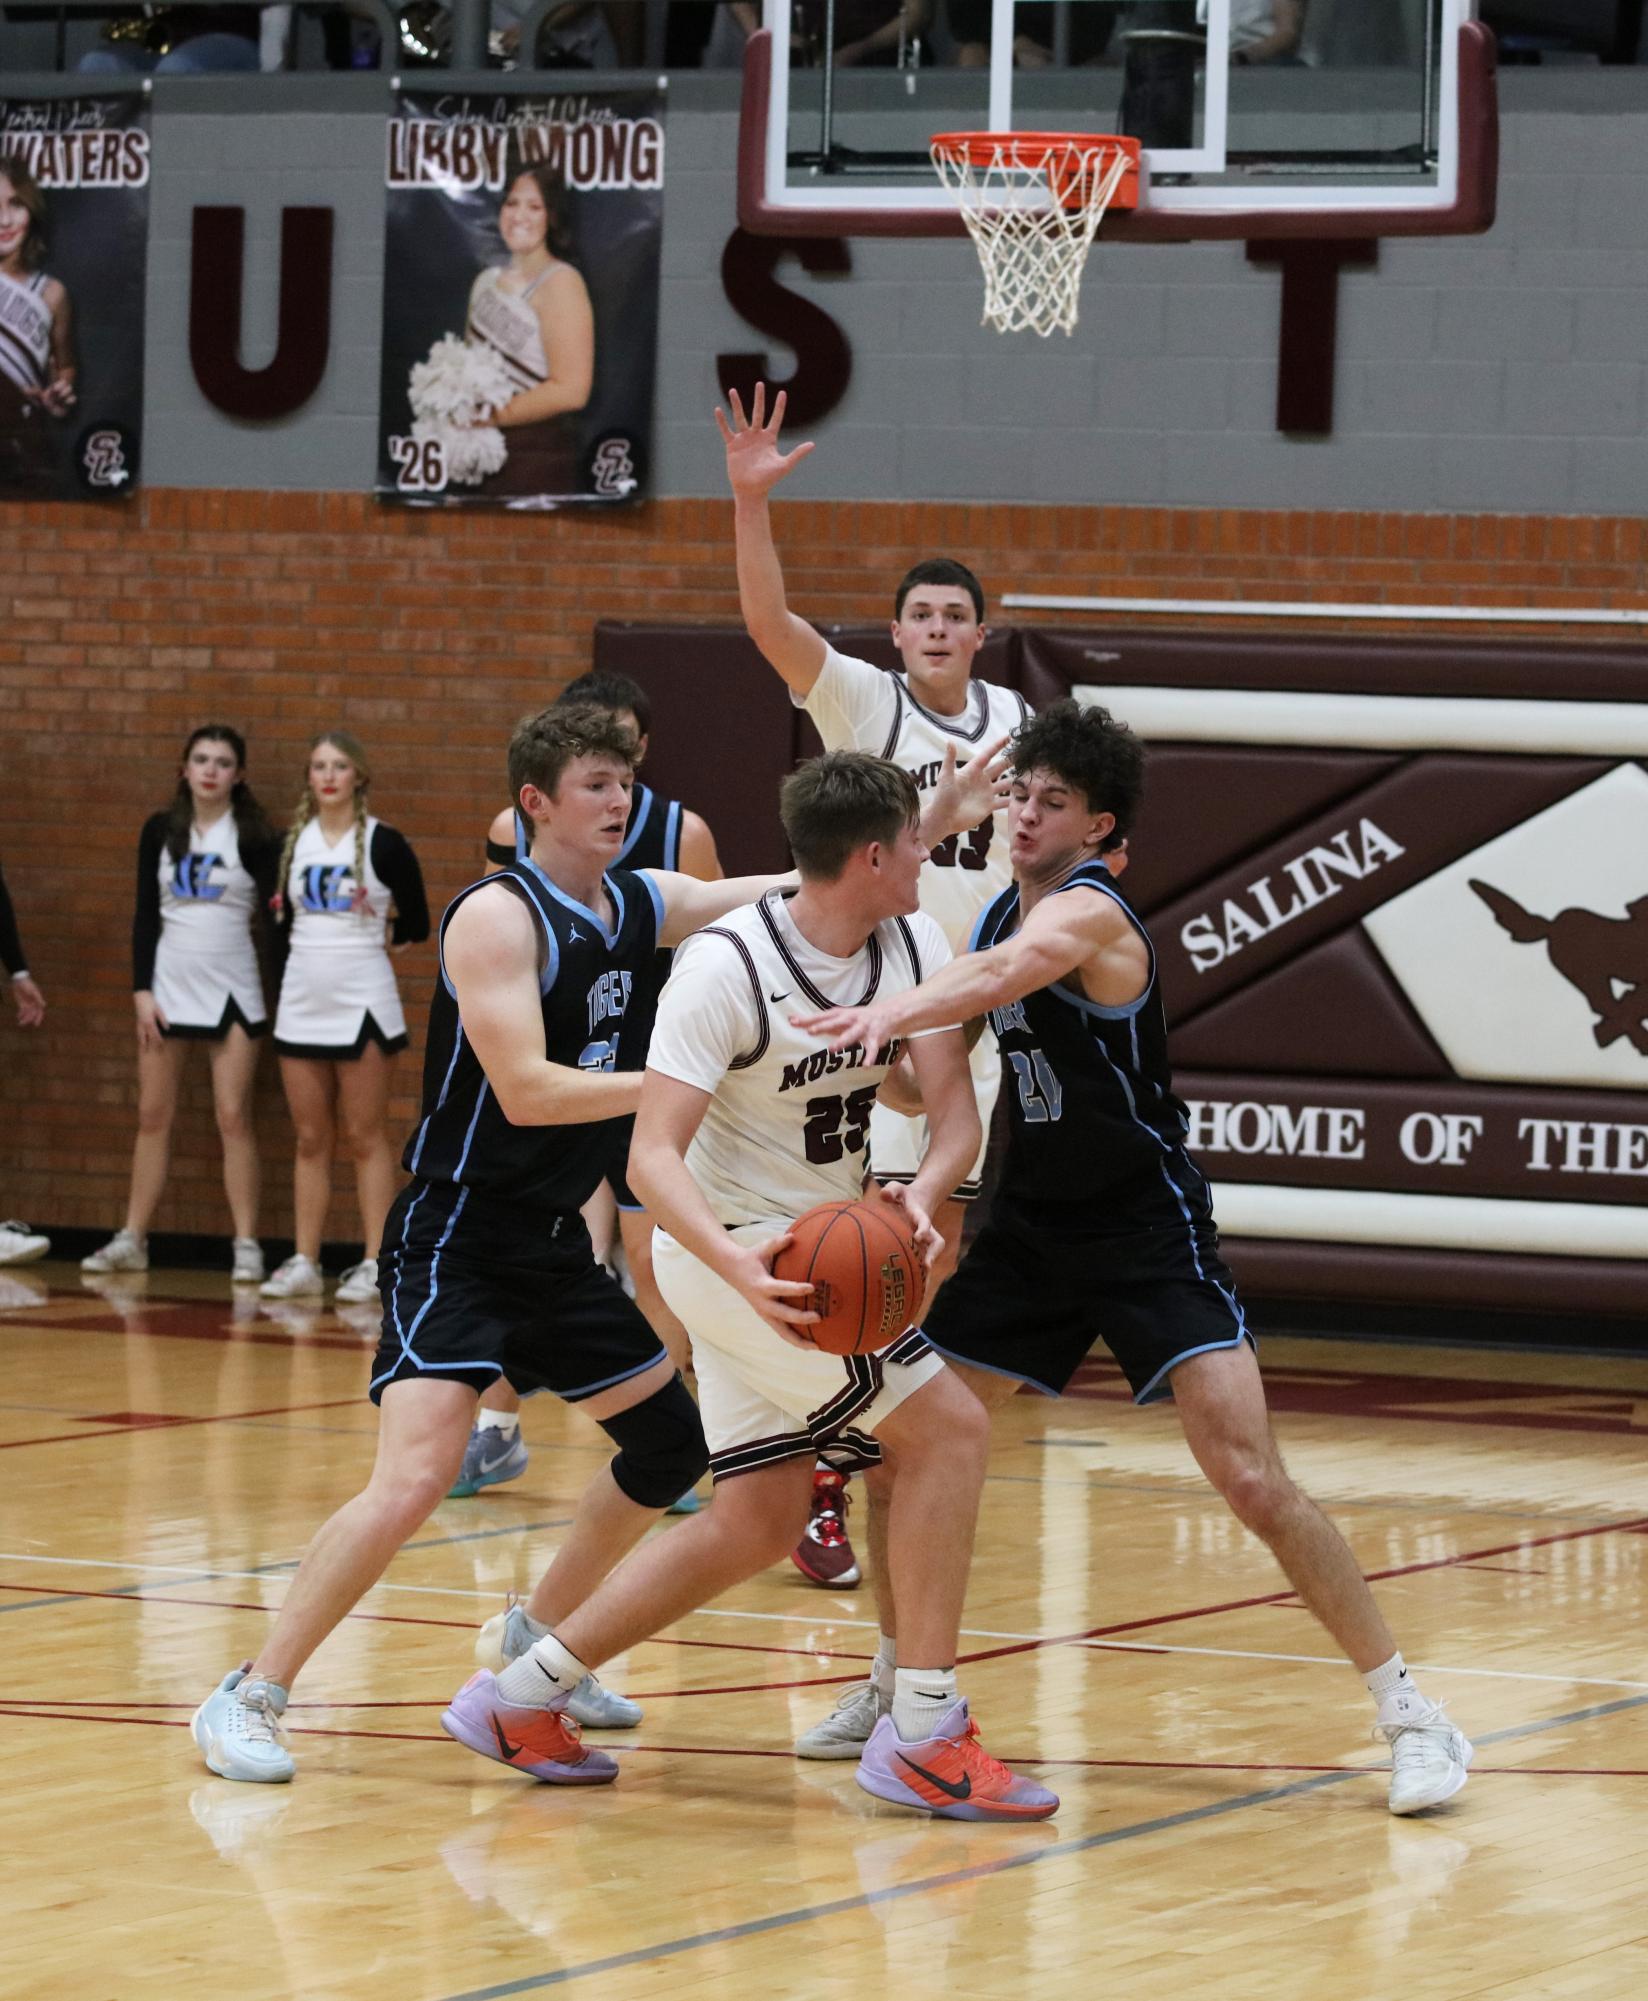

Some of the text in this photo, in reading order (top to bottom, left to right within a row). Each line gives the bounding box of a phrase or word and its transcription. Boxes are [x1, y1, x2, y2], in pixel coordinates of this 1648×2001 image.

[2, 128, 150, 189] WATERS
[386, 119, 508, 191] LIBBY
[1180, 817, 1405, 973] SALINA
[1184, 1099, 1648, 1176] HOME OF THE
